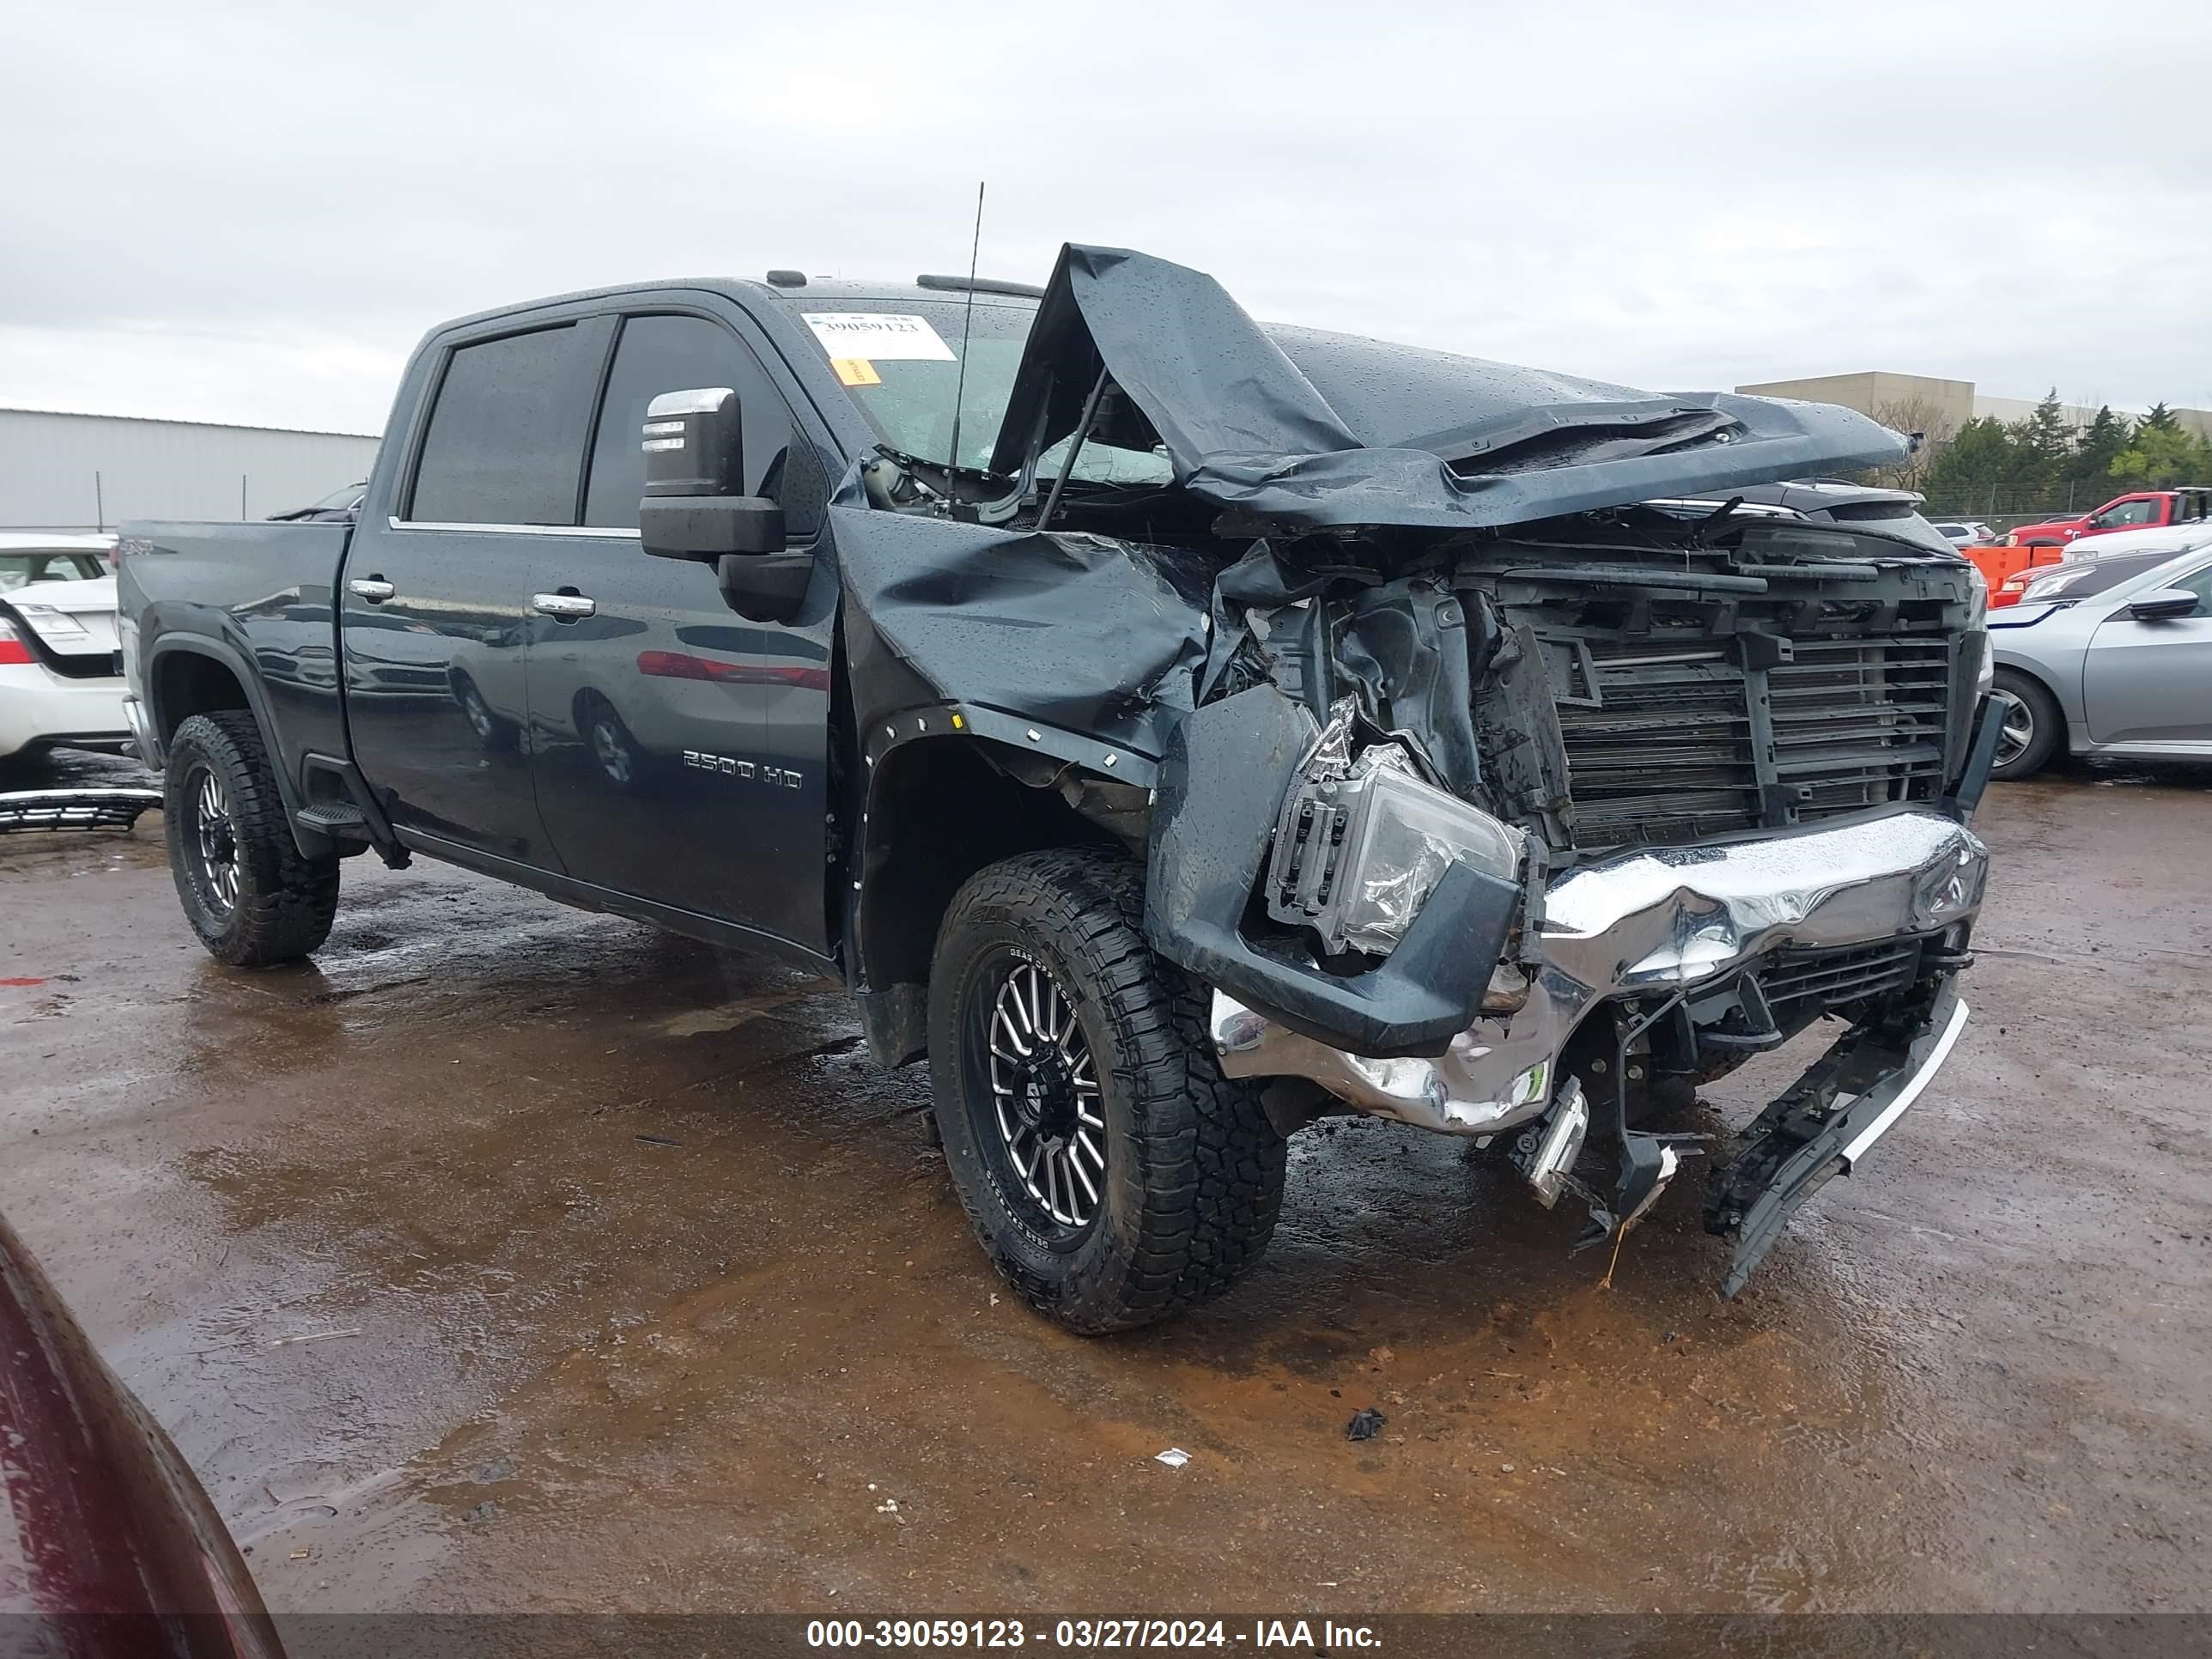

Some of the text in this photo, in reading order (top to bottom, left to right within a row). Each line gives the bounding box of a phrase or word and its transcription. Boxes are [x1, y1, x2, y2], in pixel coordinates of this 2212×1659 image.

[823, 322, 919, 332] 39059123
[683, 750, 804, 790] 2500 HD
[1010, 948, 1033, 963] GEAR
[1054, 981, 1078, 1018] ROAD
[1025, 1229, 1049, 1249] GEAR
